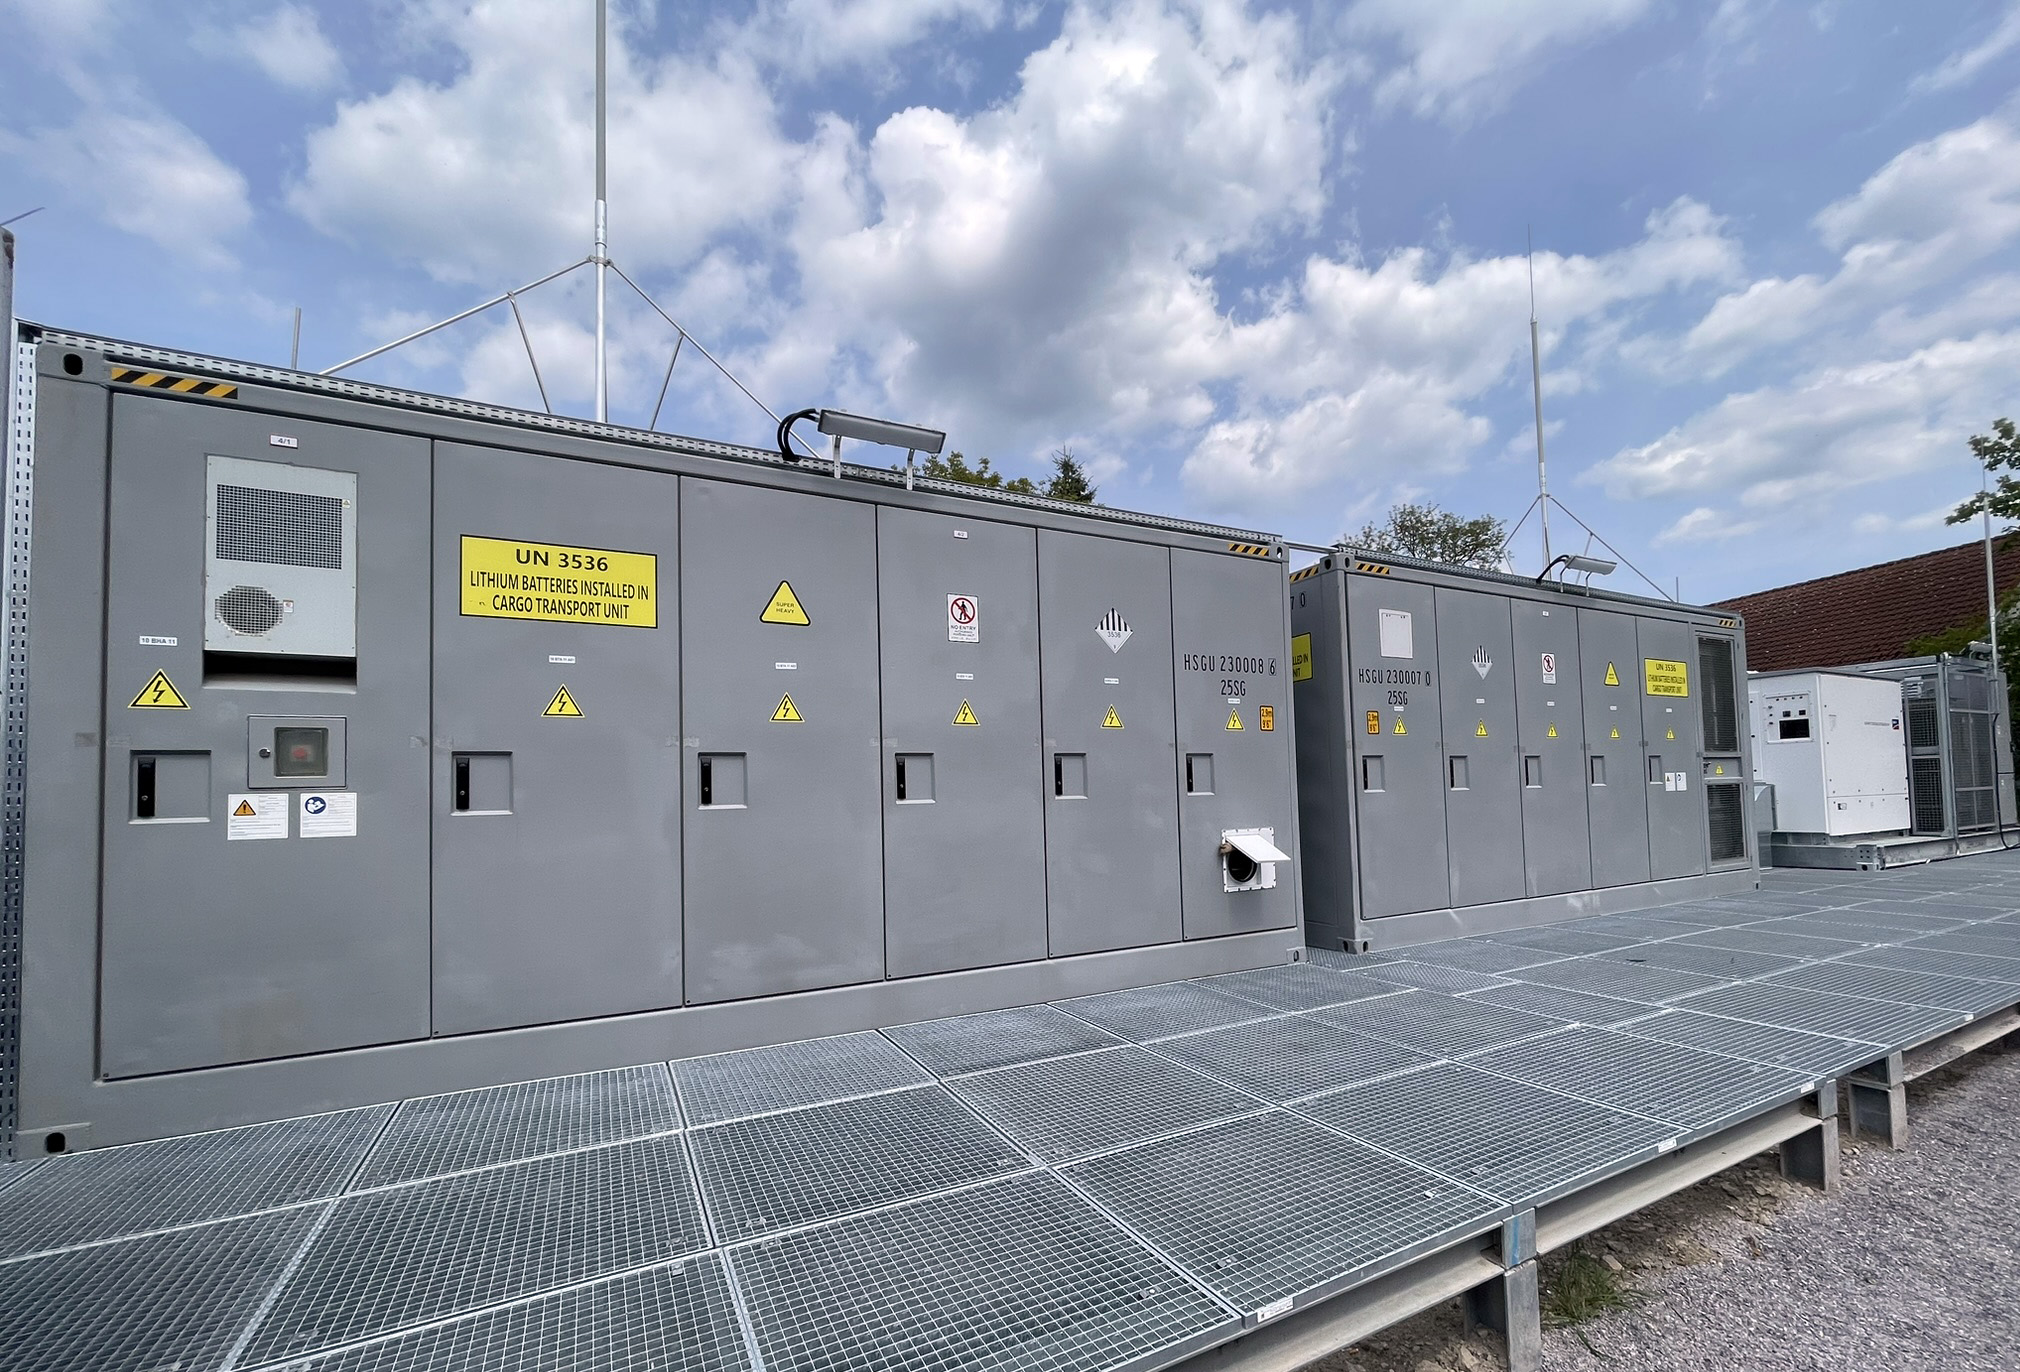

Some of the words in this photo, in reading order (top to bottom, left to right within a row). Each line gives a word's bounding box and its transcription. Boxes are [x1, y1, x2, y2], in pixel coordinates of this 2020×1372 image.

[515, 548, 549, 566] UN
[558, 552, 609, 572] 3536
[470, 570, 519, 590] LITHIUM
[522, 575, 578, 595] BATTERIES
[580, 581, 635, 599] INSTALLED
[637, 585, 649, 600] IN
[492, 594, 533, 613] CARGO
[535, 597, 601, 618] TRANSPORT
[603, 603, 630, 619] UNIT
[1300, 592, 1306, 608] 0
[1184, 653, 1215, 672] HSGU
[1220, 655, 1264, 674] 230008
[1269, 659, 1276, 675] 6
[1303, 653, 1309, 663] IN
[1655, 663, 1664, 671] UN
[1664, 664, 1677, 672] 3536
[1358, 668, 1383, 684] HSGU
[1386, 669, 1421, 685] 230007
[1425, 671, 1431, 686] 0
[1220, 679, 1246, 697] 25SG
[1387, 690, 1408, 705] 25SG
